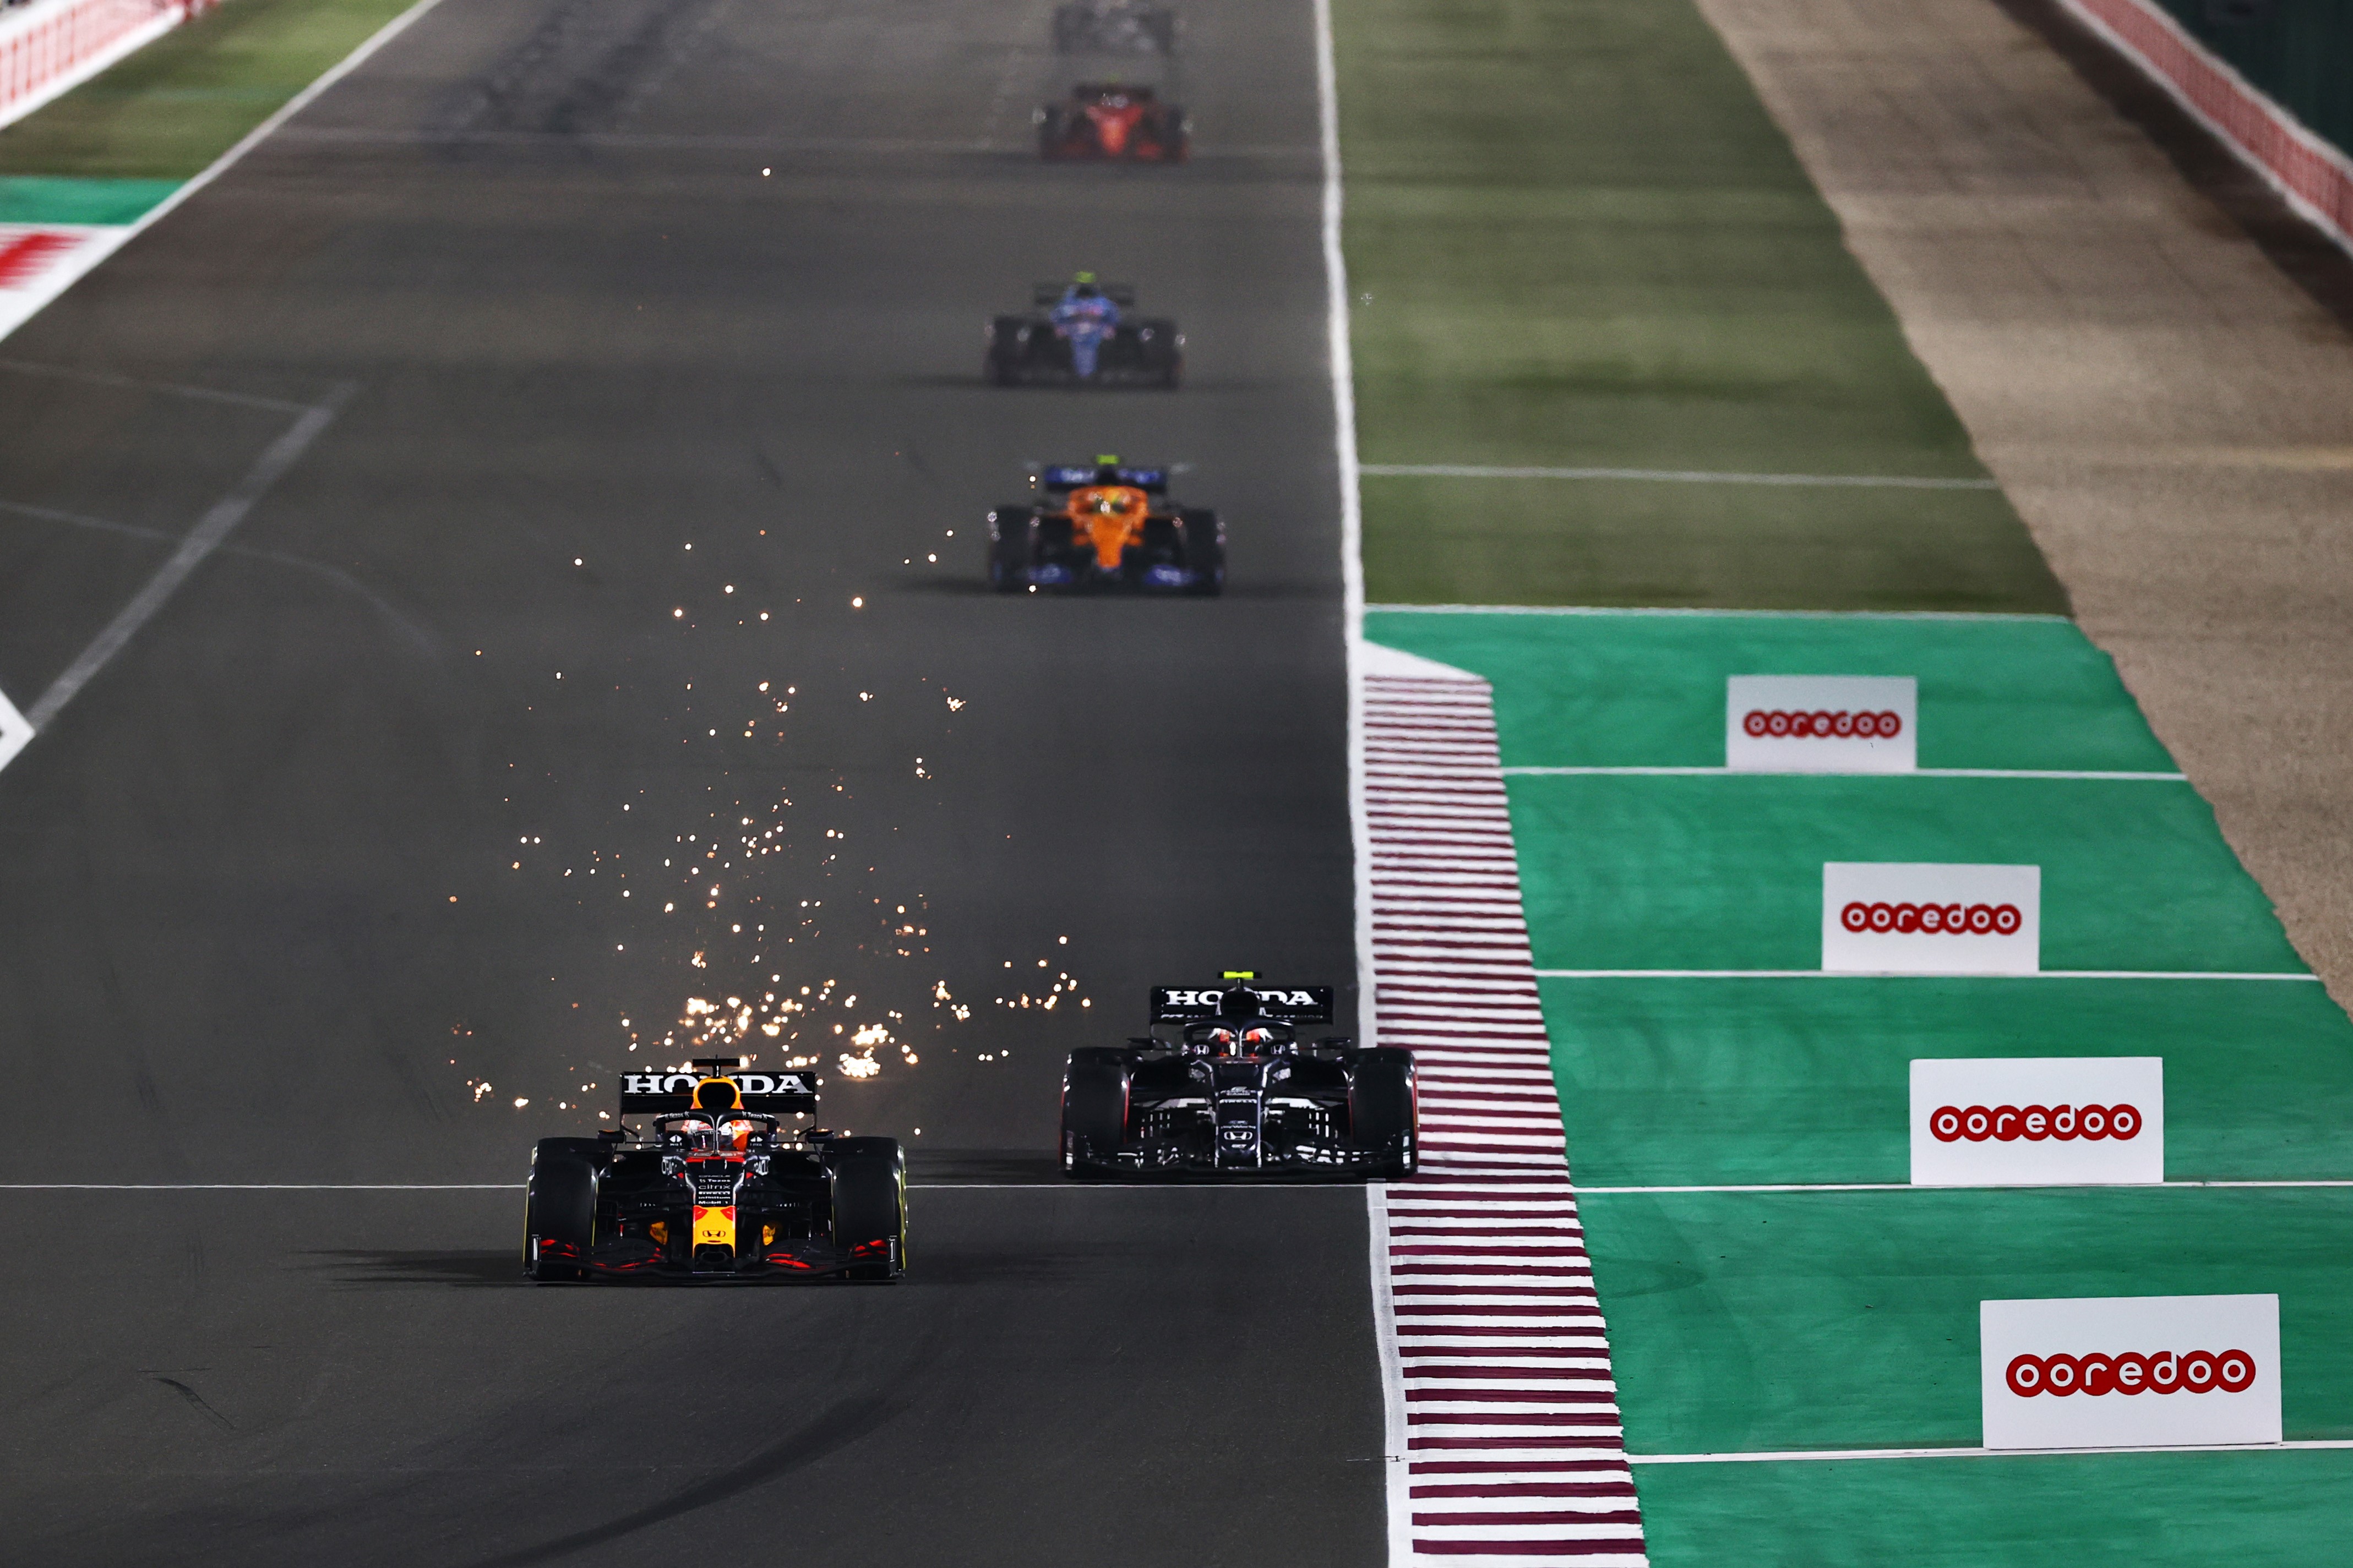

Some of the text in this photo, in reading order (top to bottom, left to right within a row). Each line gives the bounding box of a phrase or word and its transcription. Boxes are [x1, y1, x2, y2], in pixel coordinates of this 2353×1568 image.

[1746, 712, 1899, 736] ooredoo
[1845, 904, 2018, 932] ooredoo
[1165, 990, 1319, 1006] HODA
[624, 1075, 813, 1094] HODA
[1935, 1106, 2138, 1138] ooredoo
[2011, 1351, 2251, 1392] ooredoo
